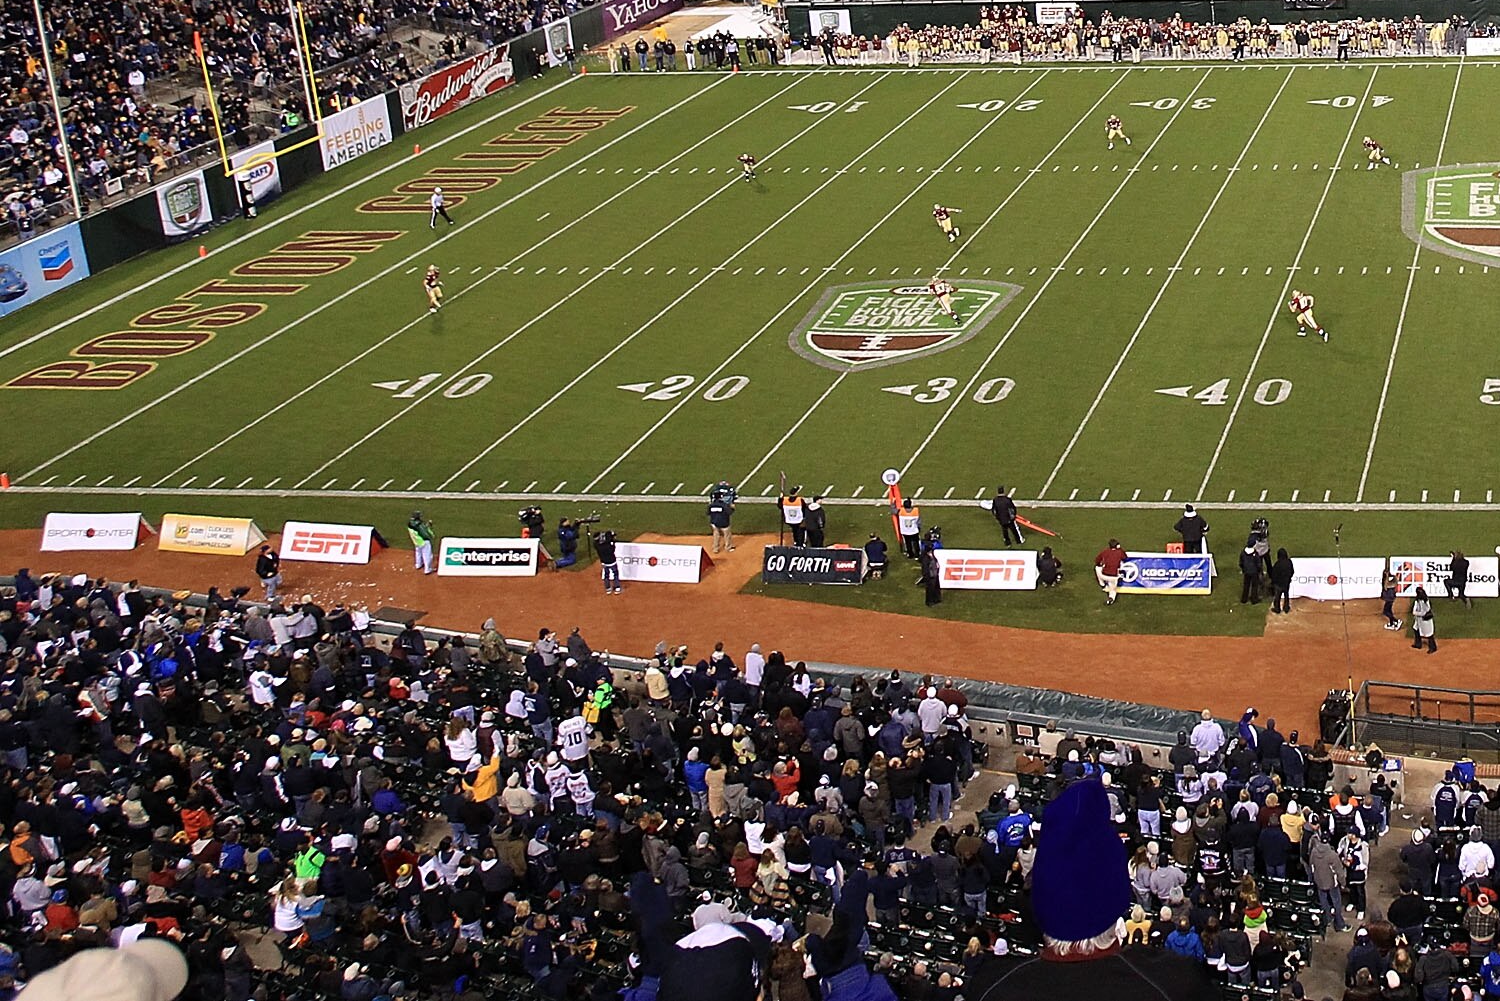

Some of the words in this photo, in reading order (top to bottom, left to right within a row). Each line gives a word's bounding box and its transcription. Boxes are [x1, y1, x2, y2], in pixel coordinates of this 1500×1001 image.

[406, 47, 498, 127] Budweiser
[326, 117, 384, 153] FEEDING
[328, 133, 387, 168] AMERICA
[249, 165, 269, 180] RAFT
[2, 230, 408, 390] BOSTON
[355, 105, 639, 215] COLLEGE
[38, 240, 68, 257] Chevron
[844, 315, 940, 328] BOWL
[290, 531, 362, 555] ESPN
[450, 550, 531, 567] enterprise
[616, 556, 697, 568] PORTSCENTER
[767, 555, 786, 573] GO
[788, 556, 832, 574] FORTH
[943, 558, 1025, 581] ESPN
[1291, 575, 1383, 585] PORTSCENTER
[568, 731, 583, 746] 10
